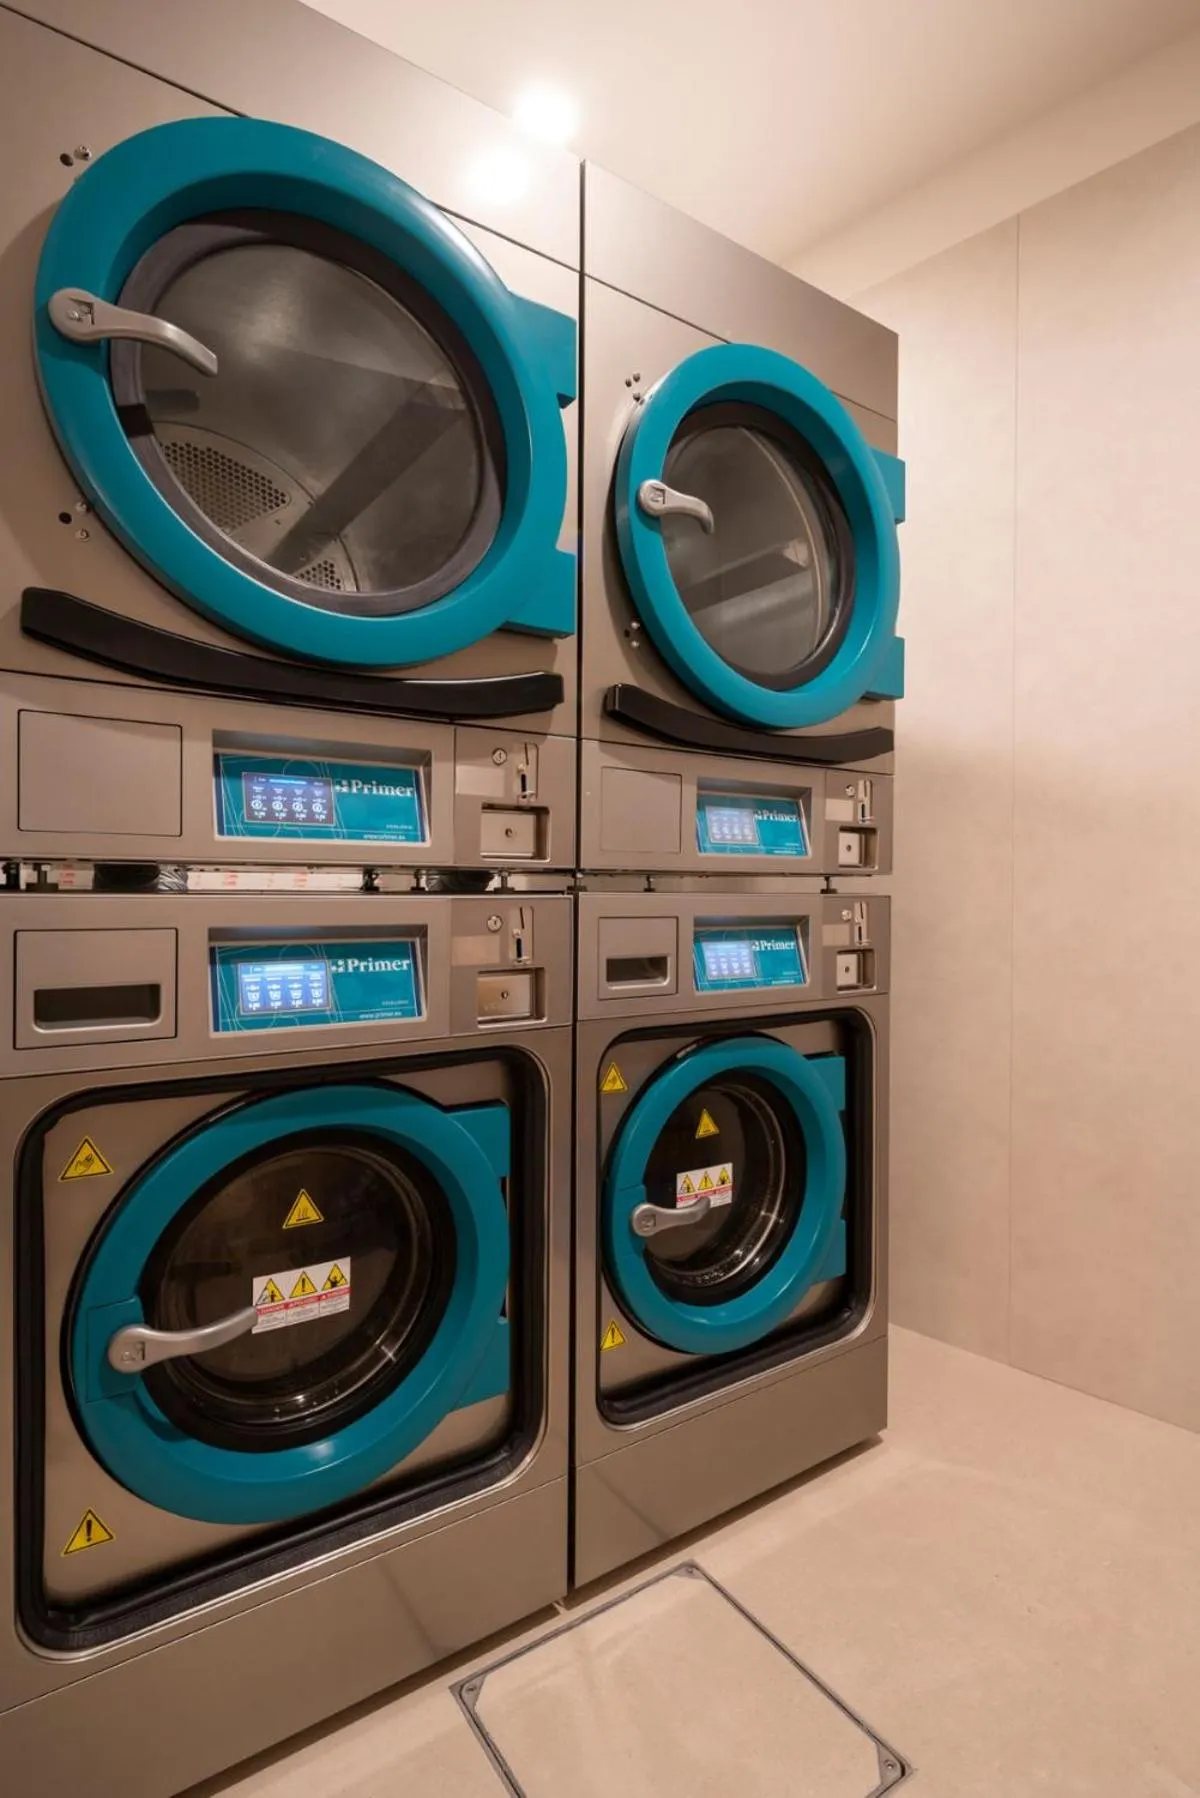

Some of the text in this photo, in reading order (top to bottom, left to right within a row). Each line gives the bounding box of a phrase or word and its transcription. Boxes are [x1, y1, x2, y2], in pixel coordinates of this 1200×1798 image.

[351, 779, 414, 797] Primer
[762, 809, 797, 823] Primer
[760, 939, 796, 951] Primer
[347, 957, 411, 973] Primer
